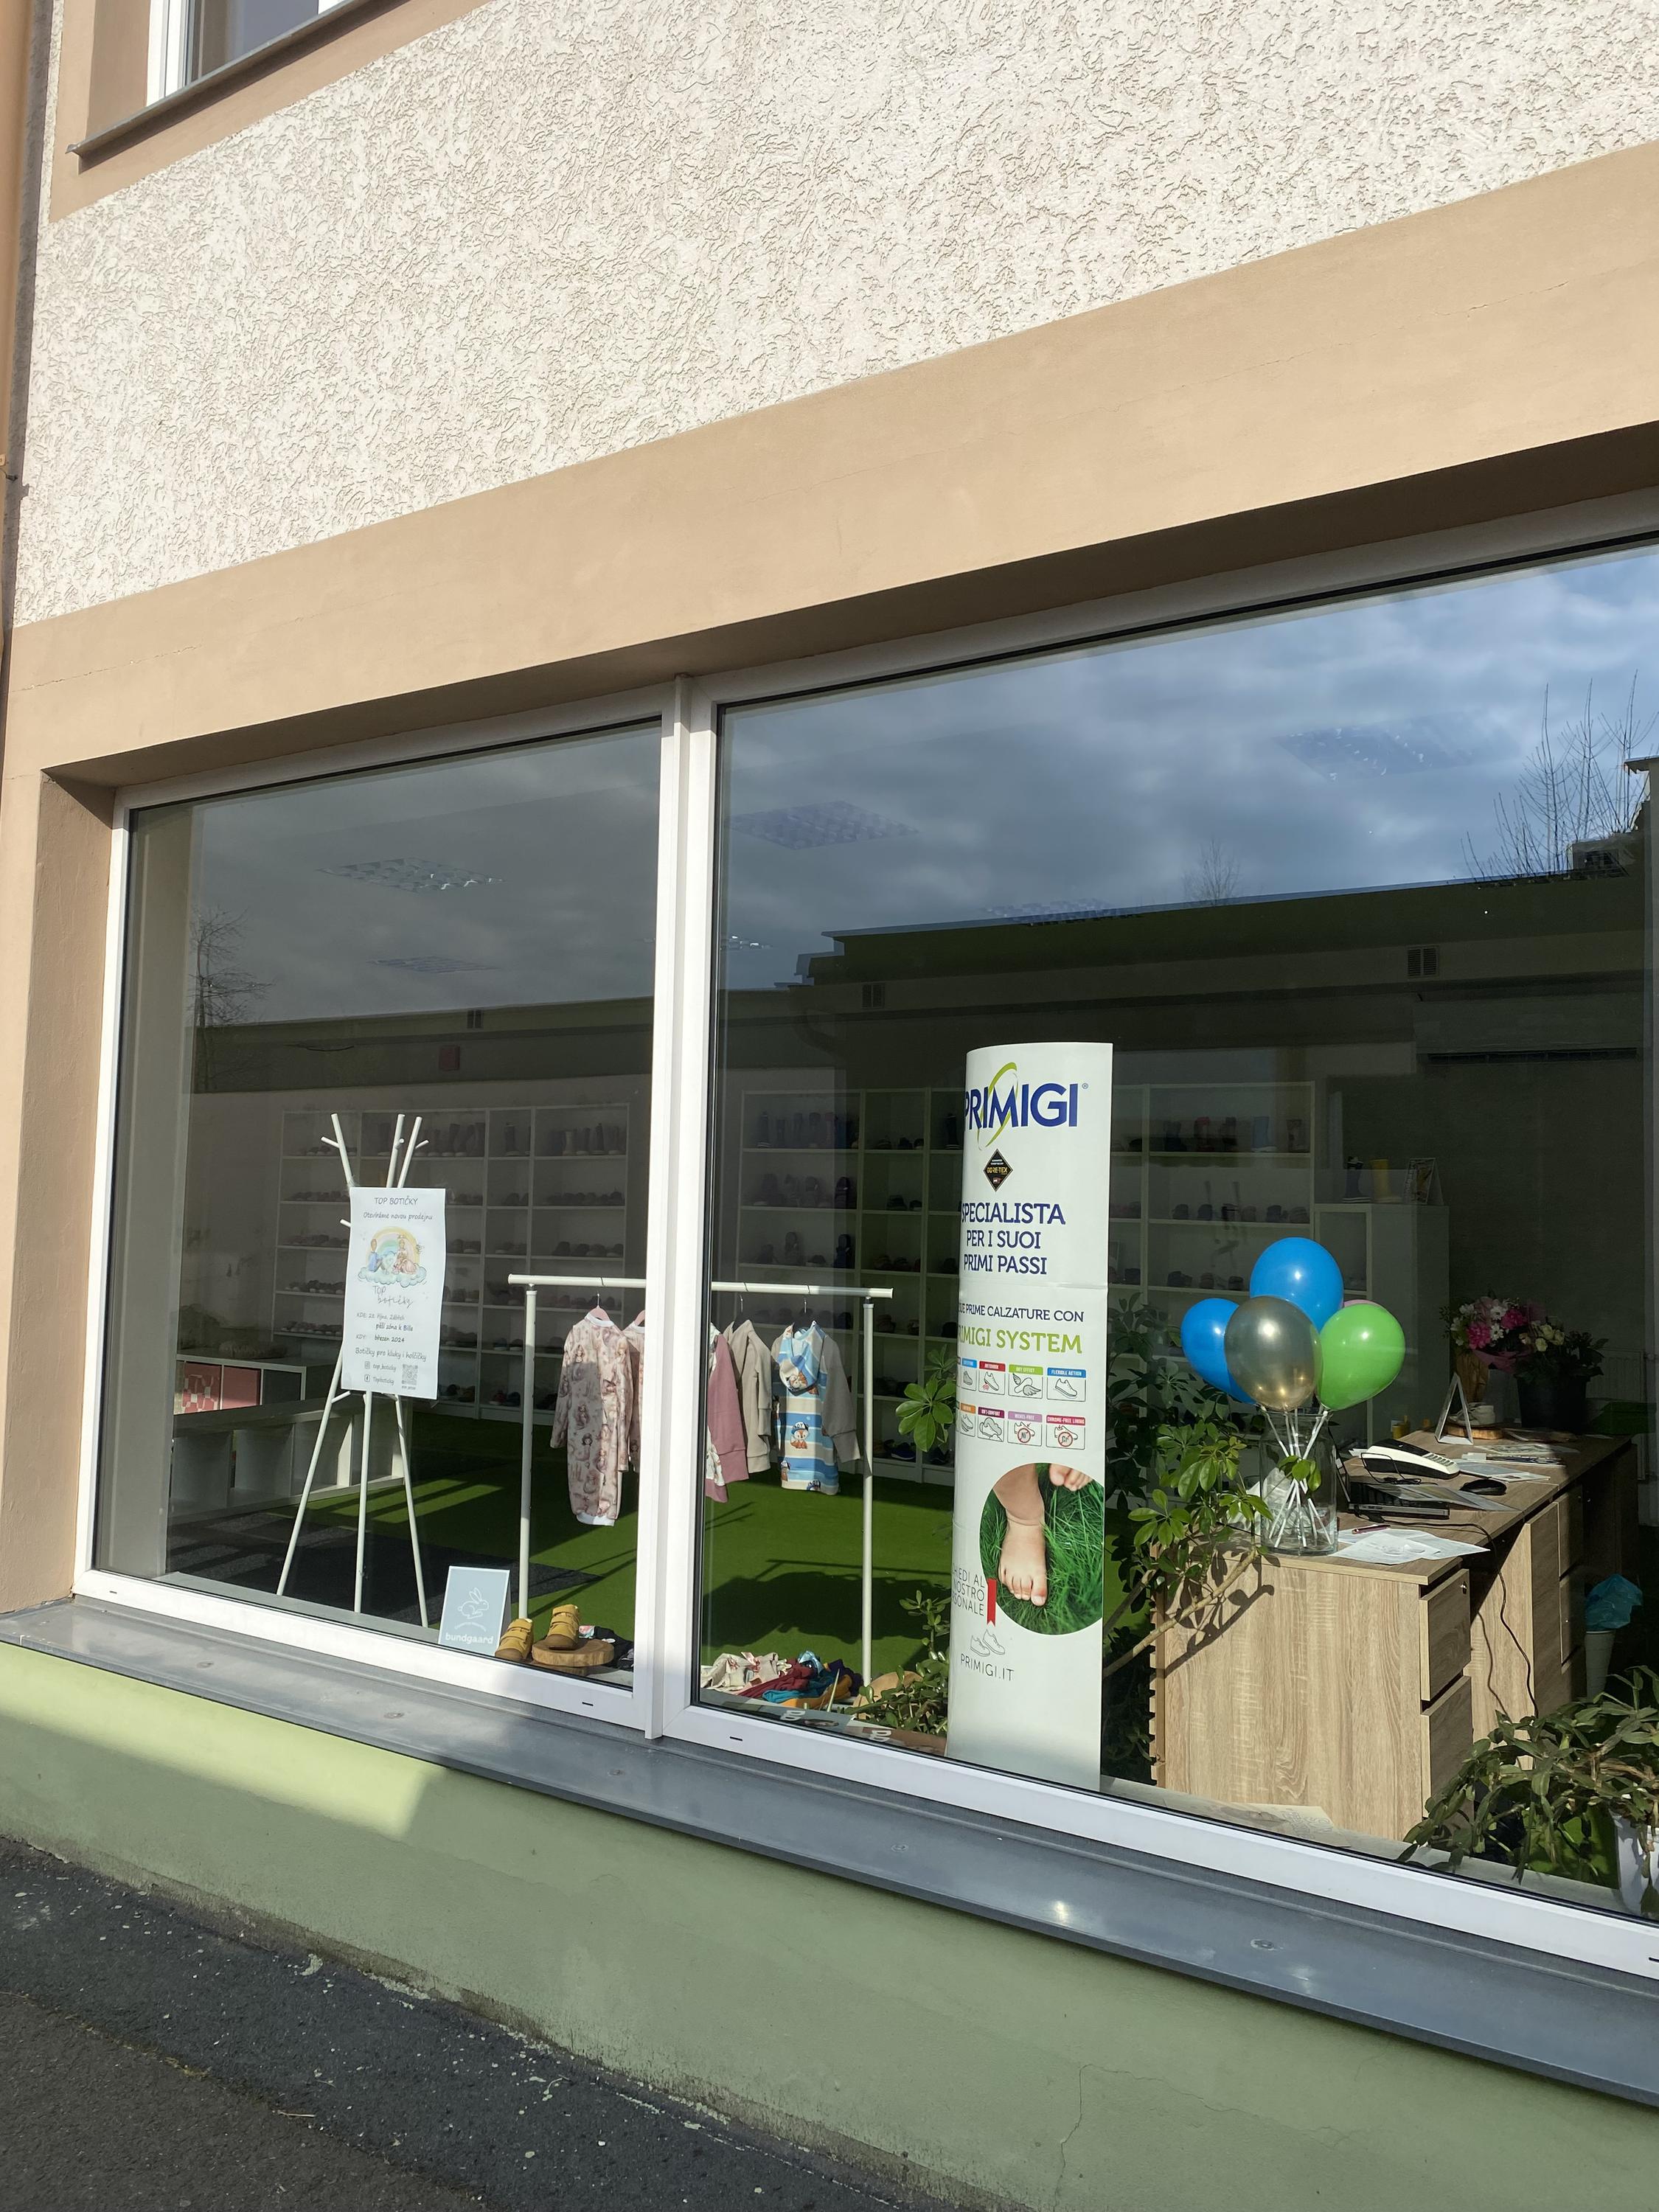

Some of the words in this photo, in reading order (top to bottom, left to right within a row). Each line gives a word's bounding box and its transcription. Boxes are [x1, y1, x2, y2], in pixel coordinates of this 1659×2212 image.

[964, 1082, 1079, 1130] PRIMIGI
[375, 1197, 388, 1205] TOP
[389, 1195, 419, 1206] BOTIČKY
[408, 1213, 433, 1222] prodejnu
[961, 1202, 1066, 1225] SPECIALISTA
[967, 1230, 984, 1247] PER
[988, 1230, 993, 1248] I
[997, 1230, 1041, 1250] SUOI
[964, 1253, 993, 1272] PRIMI
[998, 1255, 1047, 1275] PASSI
[966, 1304, 985, 1316] PRIME
[987, 1305, 1051, 1321] CALZATURE
[1054, 1310, 1085, 1323] CON
[996, 1329, 1082, 1354] SYSTEM
[973, 1574, 985, 1588] AL
[445, 1632, 494, 1644] bundgaard
[961, 1653, 1015, 1681] PRIMIGI.IT
